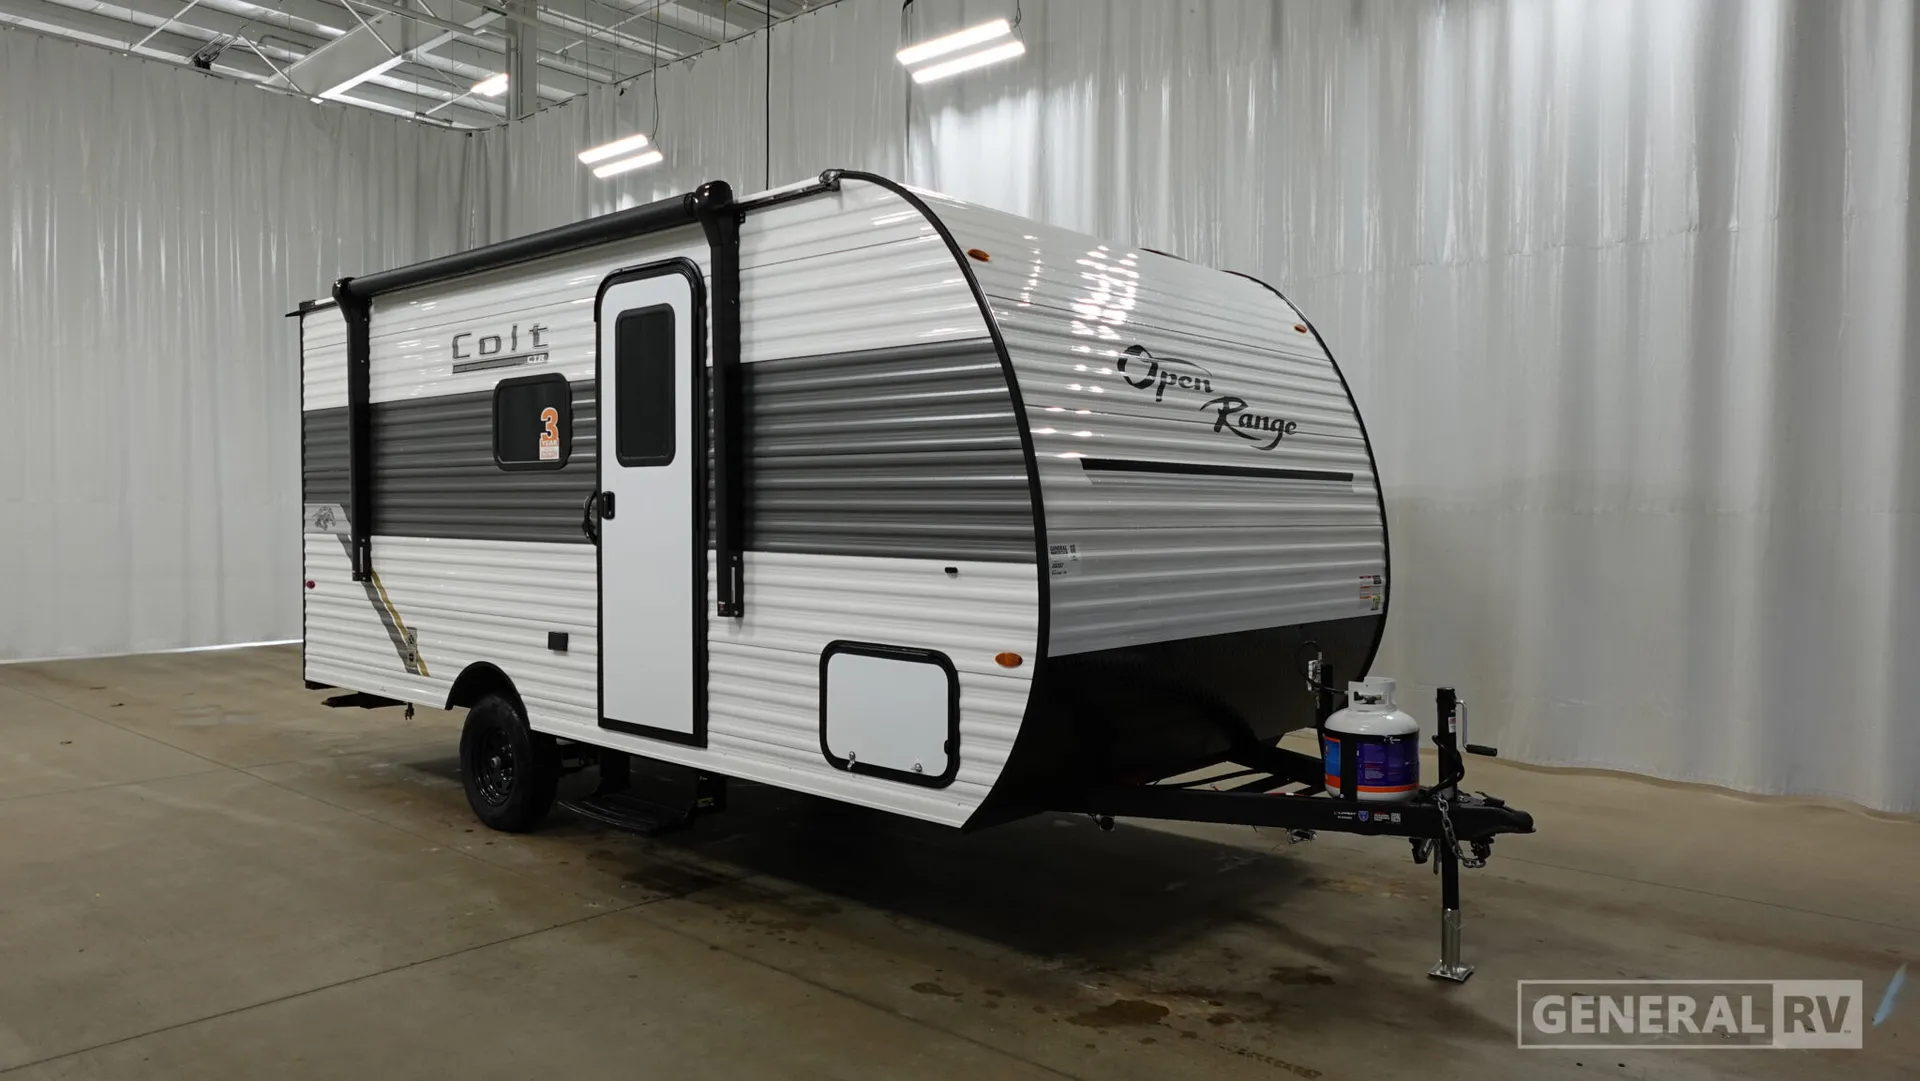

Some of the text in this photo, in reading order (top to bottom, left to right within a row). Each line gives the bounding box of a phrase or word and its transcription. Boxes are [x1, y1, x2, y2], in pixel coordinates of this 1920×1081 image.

[452, 323, 549, 359] Colt
[1117, 344, 1214, 402] Open
[541, 407, 559, 441] 3
[1200, 396, 1297, 450] Range
